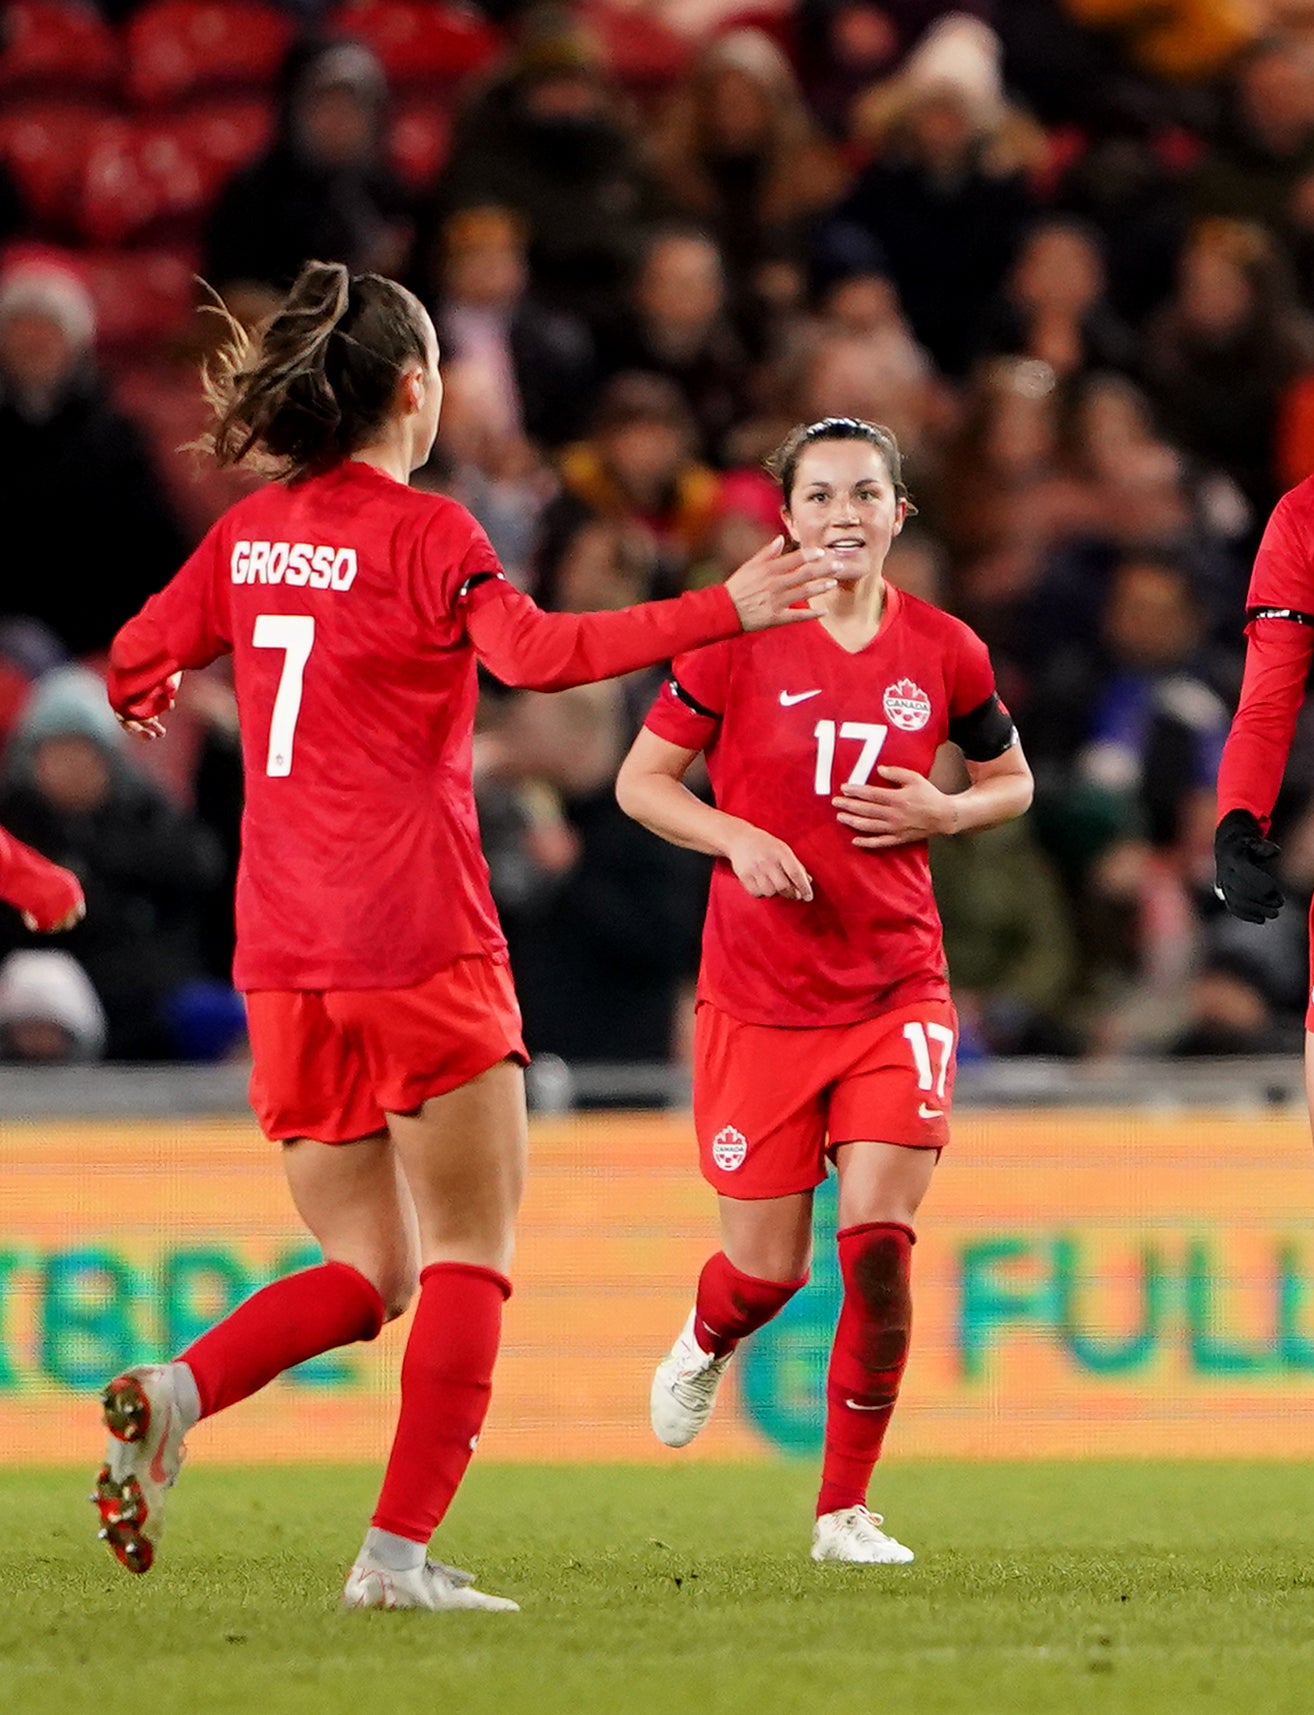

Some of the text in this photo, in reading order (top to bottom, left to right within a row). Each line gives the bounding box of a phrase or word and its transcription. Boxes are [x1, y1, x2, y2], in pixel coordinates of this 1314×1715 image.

[231, 541, 358, 592] GROSSO
[253, 614, 315, 777] 7
[885, 699, 929, 711] CANADA
[814, 719, 888, 795] 17
[903, 1021, 954, 1098] 17
